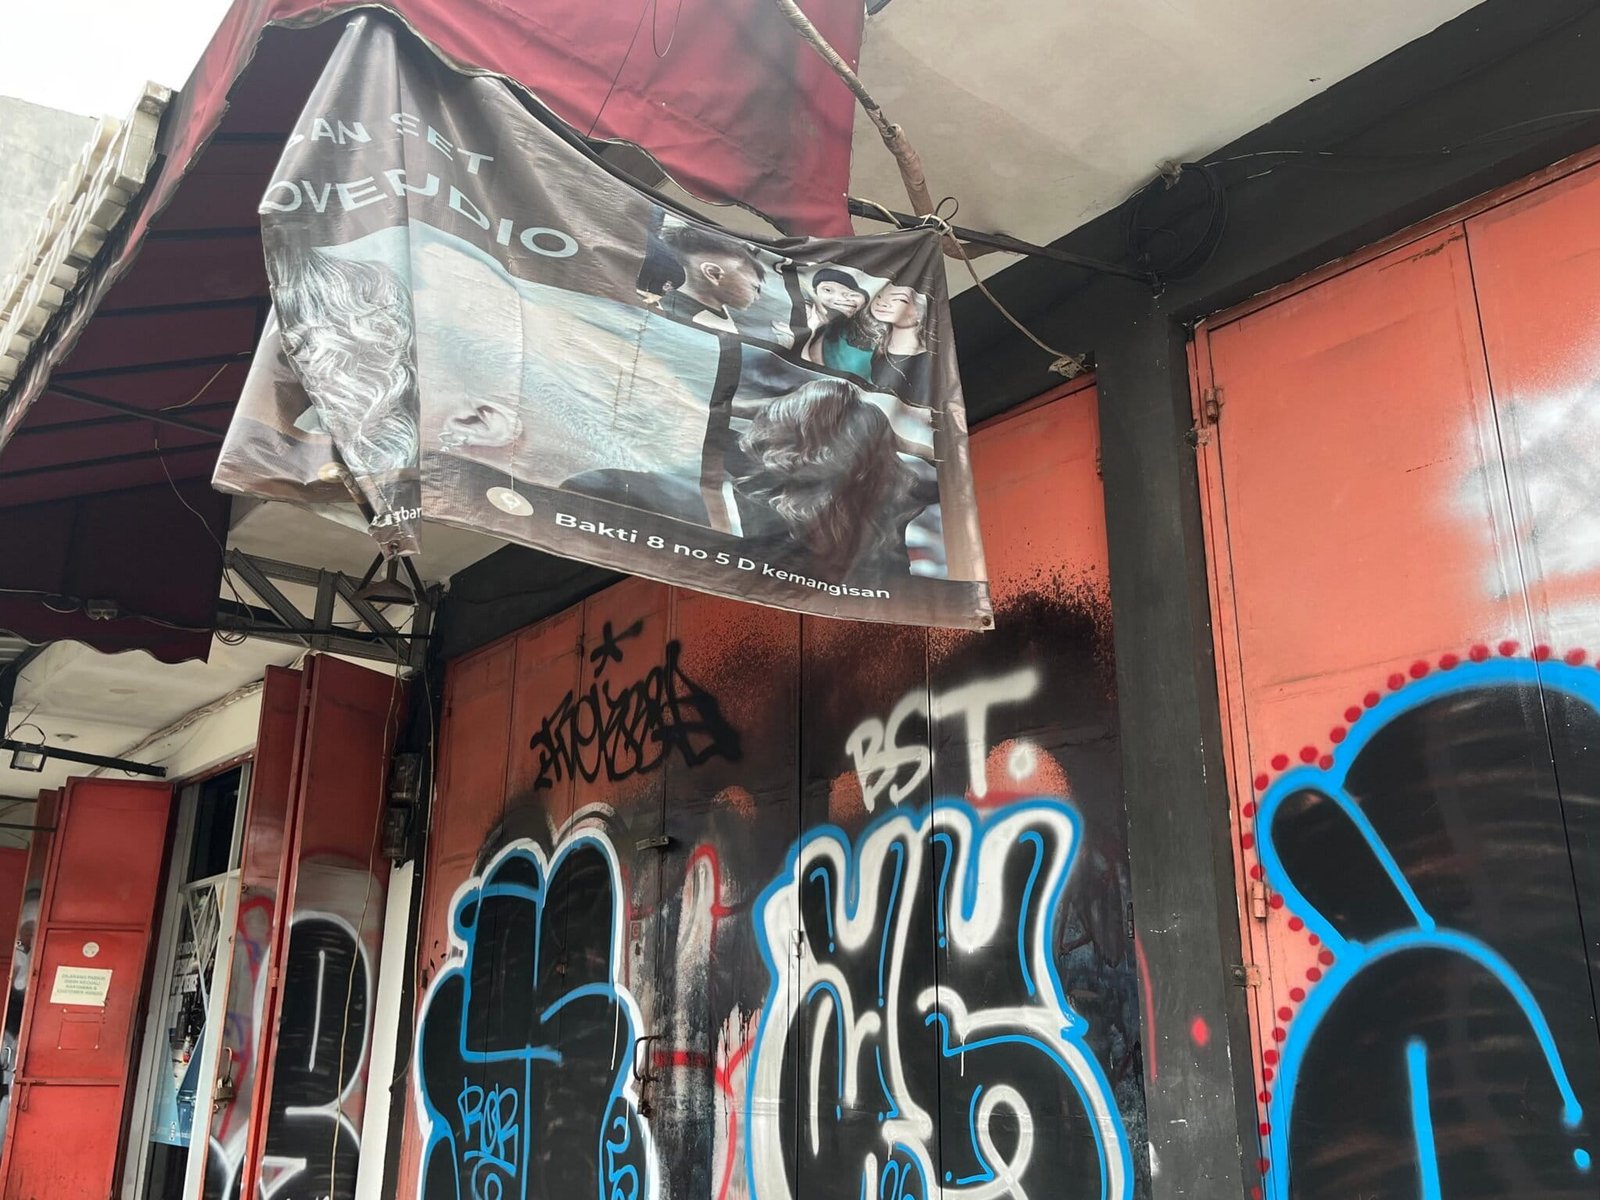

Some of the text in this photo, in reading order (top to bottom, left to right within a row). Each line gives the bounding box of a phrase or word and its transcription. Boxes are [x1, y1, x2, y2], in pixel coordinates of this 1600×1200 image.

[555, 512, 890, 599] Bakti 8 no 5 D kemangisan
